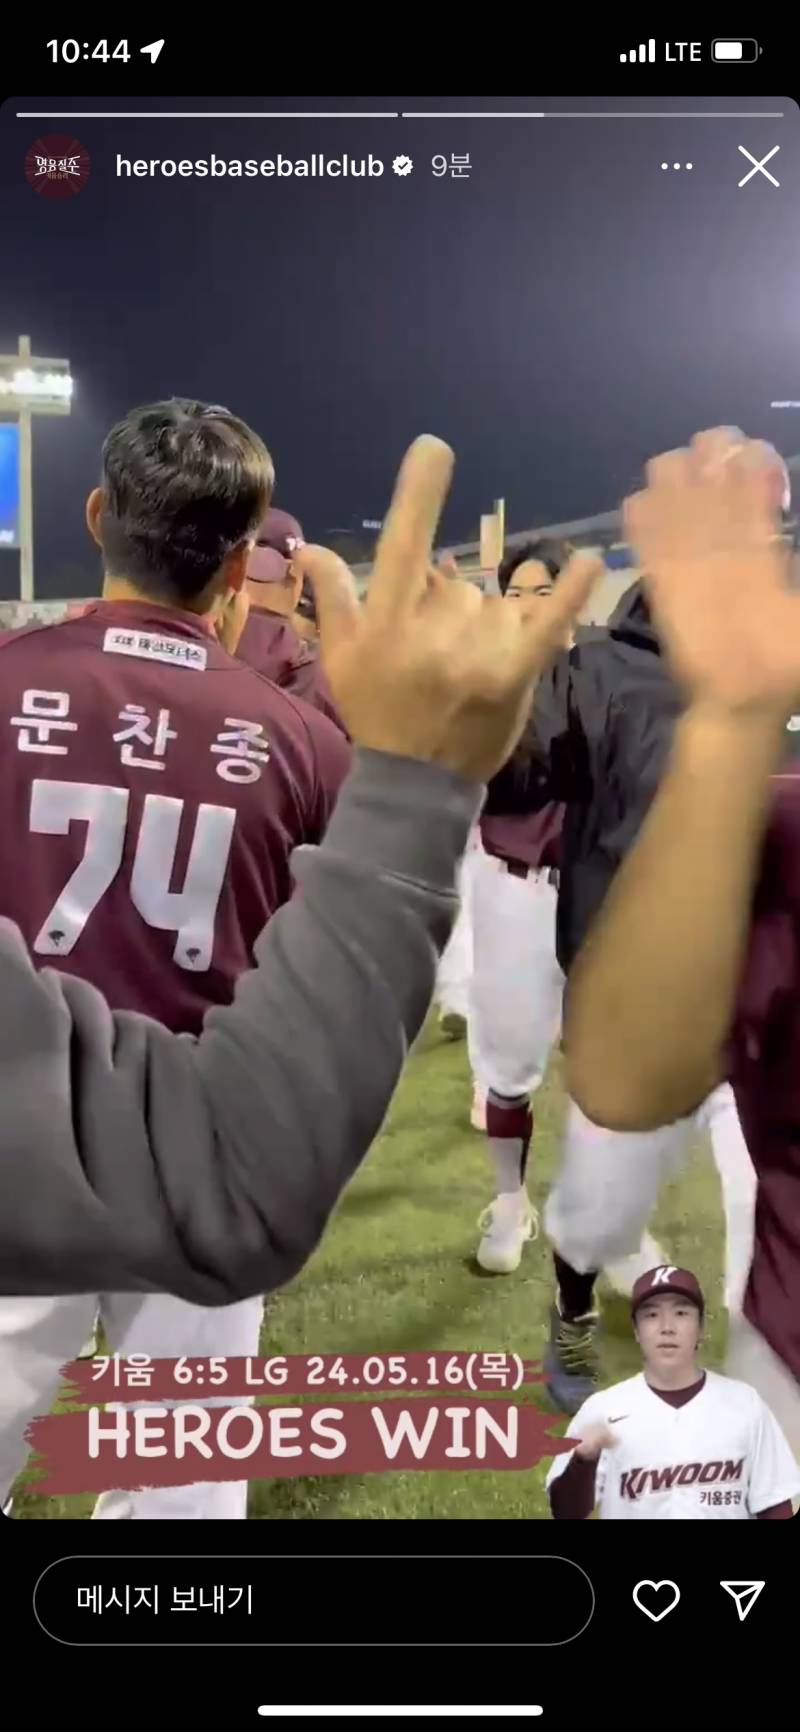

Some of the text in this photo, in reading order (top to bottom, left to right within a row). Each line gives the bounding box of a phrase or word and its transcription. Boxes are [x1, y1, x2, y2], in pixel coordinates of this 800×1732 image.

[29, 778, 237, 973] 74
[651, 1266, 678, 1286] K
[620, 1459, 744, 1500] KIWOOM
[699, 1491, 742, 1507] 키움증권
